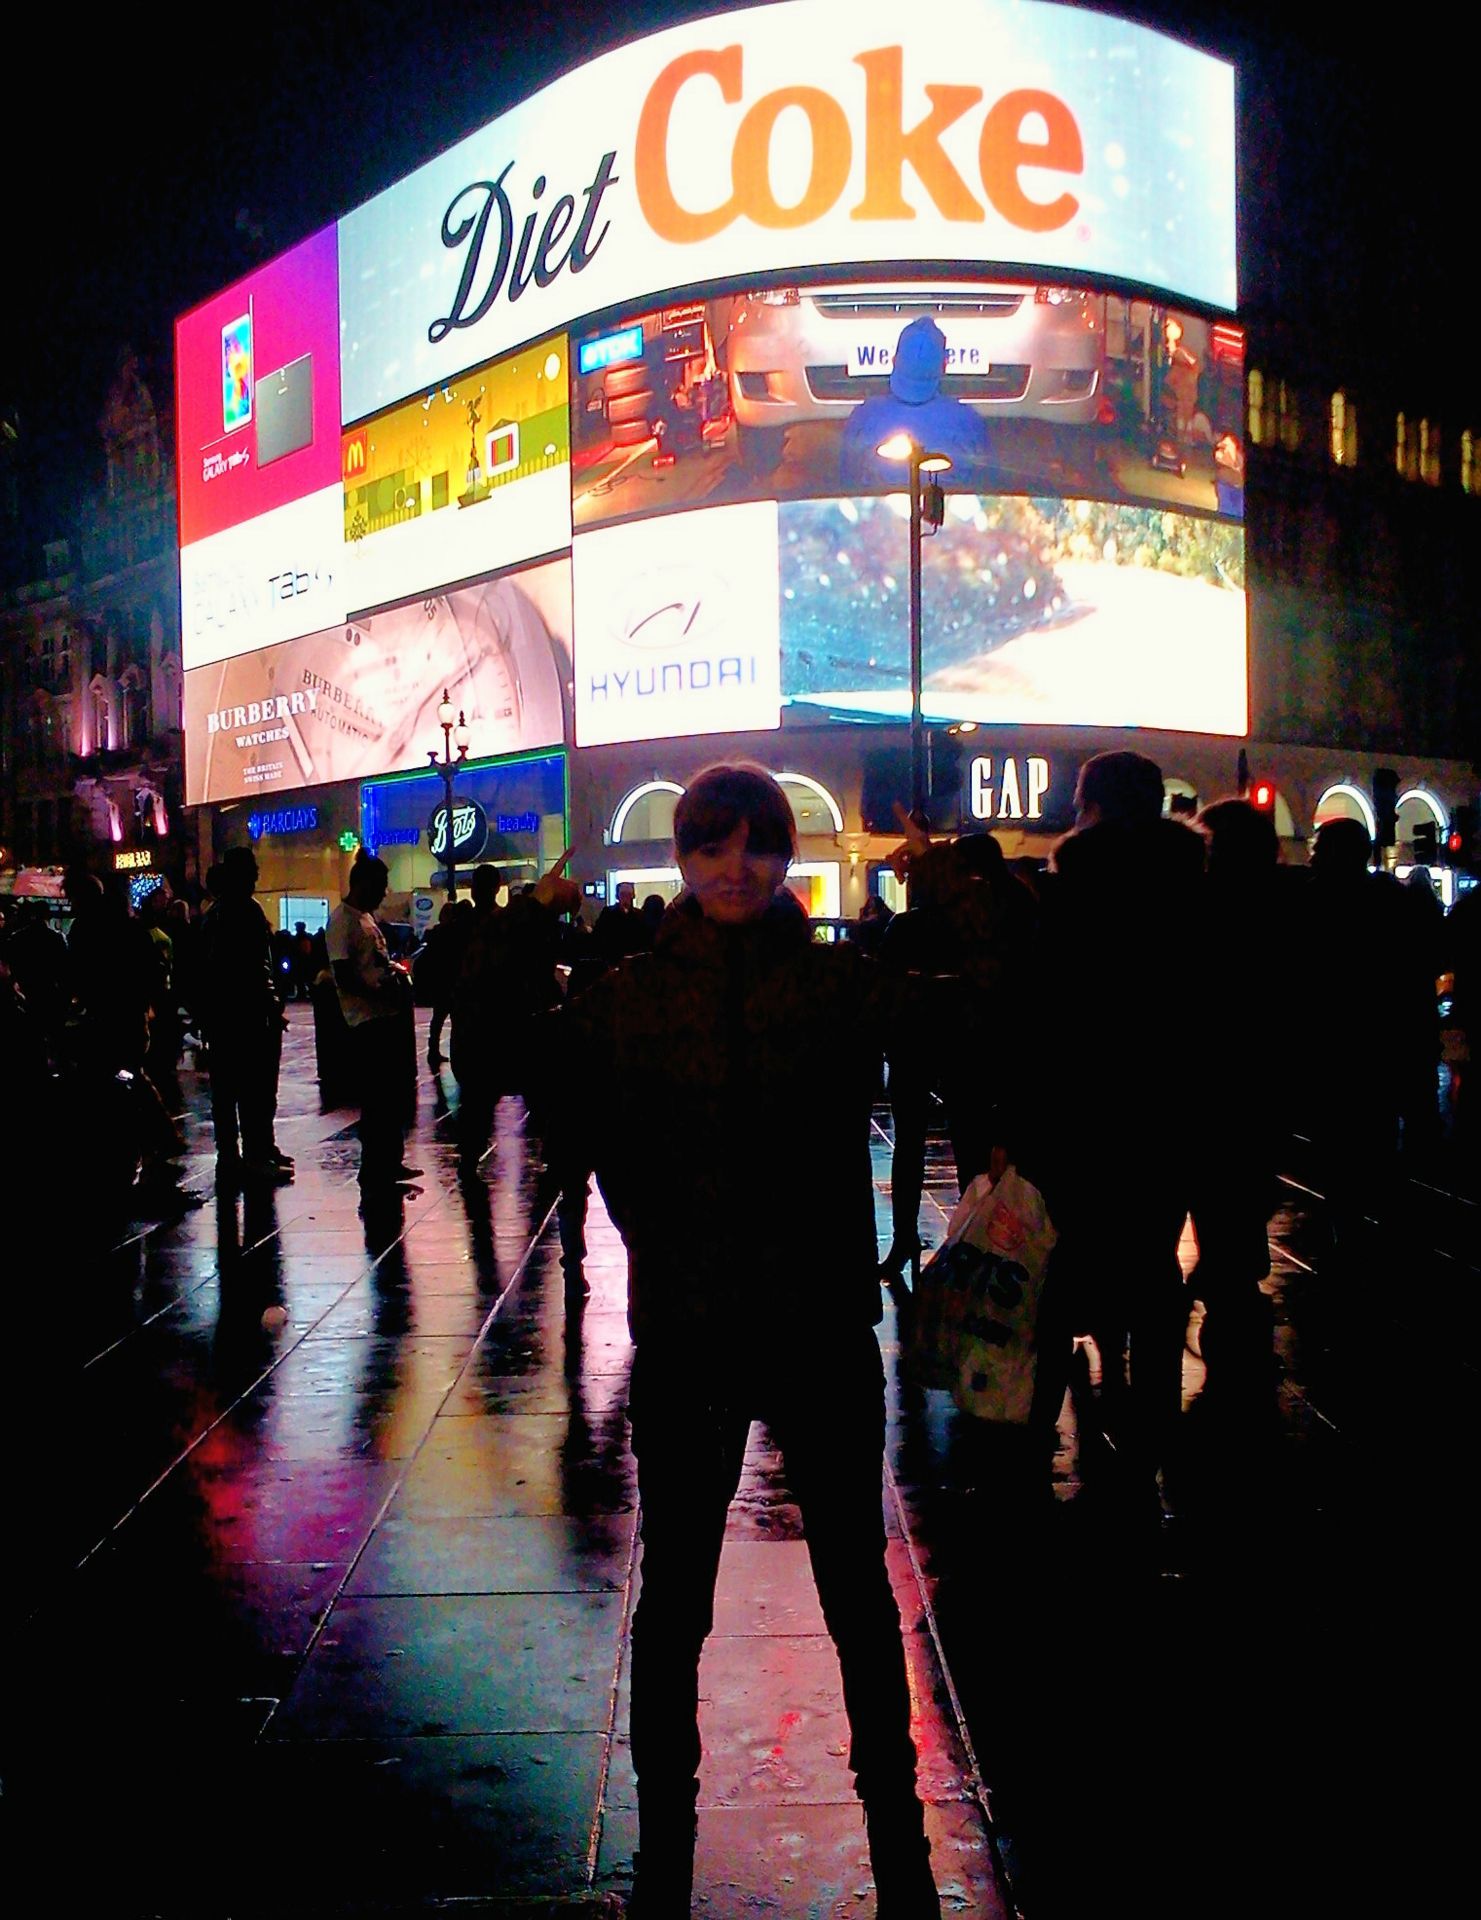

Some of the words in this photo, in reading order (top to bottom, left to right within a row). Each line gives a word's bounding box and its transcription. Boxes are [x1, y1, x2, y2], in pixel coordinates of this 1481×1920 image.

[427, 151, 619, 345] Diet
[634, 44, 1085, 244] Coke
[590, 656, 756, 702] HYUNDAI
[207, 687, 321, 734] BURBERRY
[235, 726, 290, 749] WATCHES
[971, 757, 1050, 819] GAP
[262, 808, 318, 834] BARCLAYS
